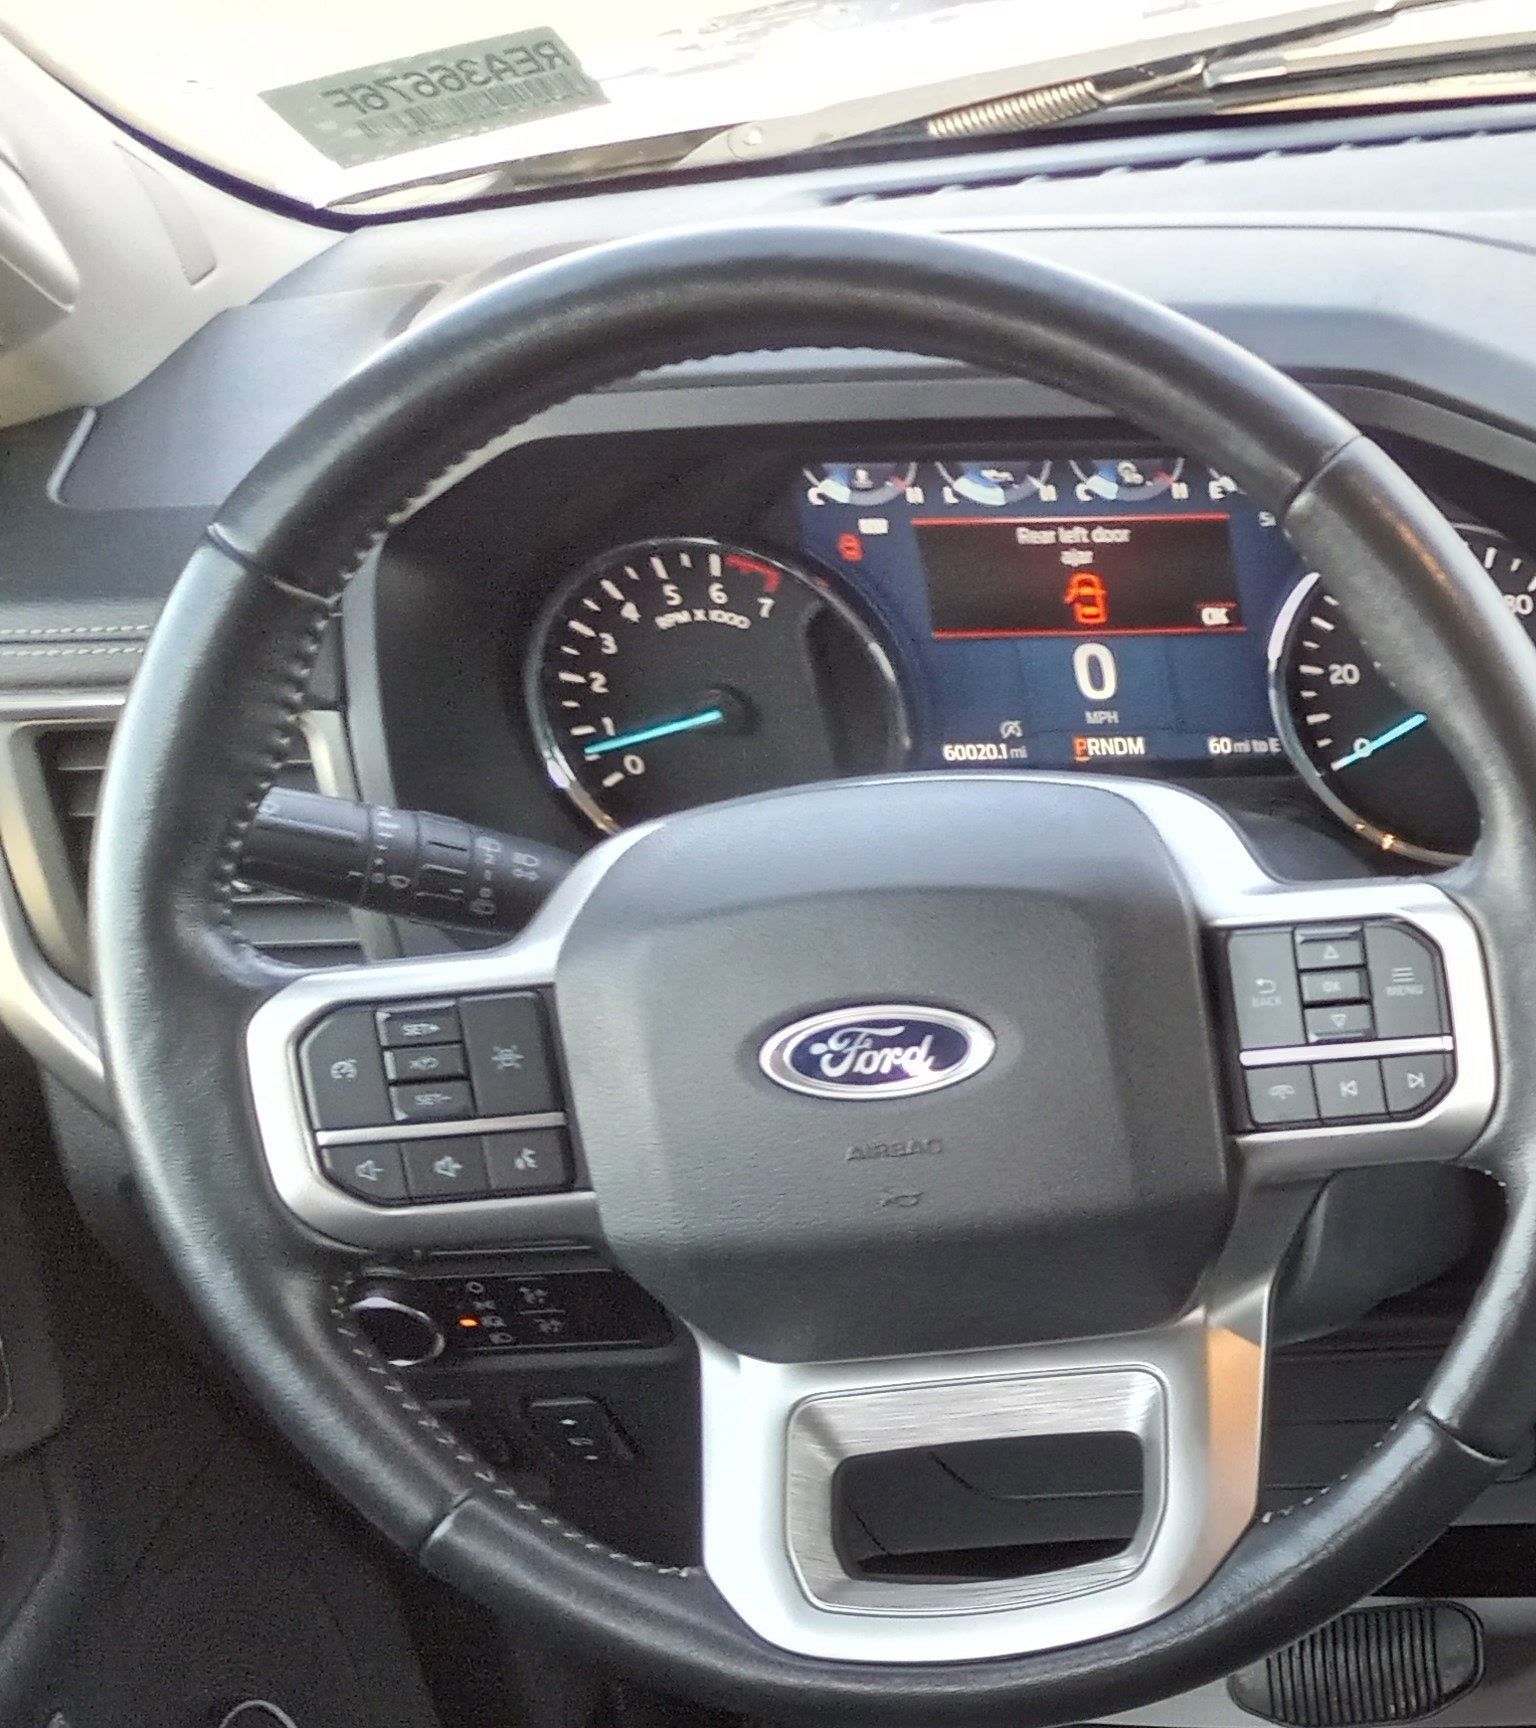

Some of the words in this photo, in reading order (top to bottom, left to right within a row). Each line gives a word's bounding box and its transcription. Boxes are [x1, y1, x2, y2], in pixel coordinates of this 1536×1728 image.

[662, 583, 682, 606] 5
[709, 582, 728, 604] 6
[757, 598, 775, 618] 7
[599, 632, 618, 655] 3
[588, 671, 608, 694] 2
[1072, 643, 1118, 700] 0
[1328, 663, 1361, 686] 20
[601, 716, 615, 736] 1
[1084, 711, 1119, 725] MPH
[1207, 736, 1231, 754] 60
[623, 754, 645, 778] 0
[1322, 980, 1341, 992] OK
[1385, 985, 1423, 996] MENU
[808, 1025, 938, 1078] Ford
